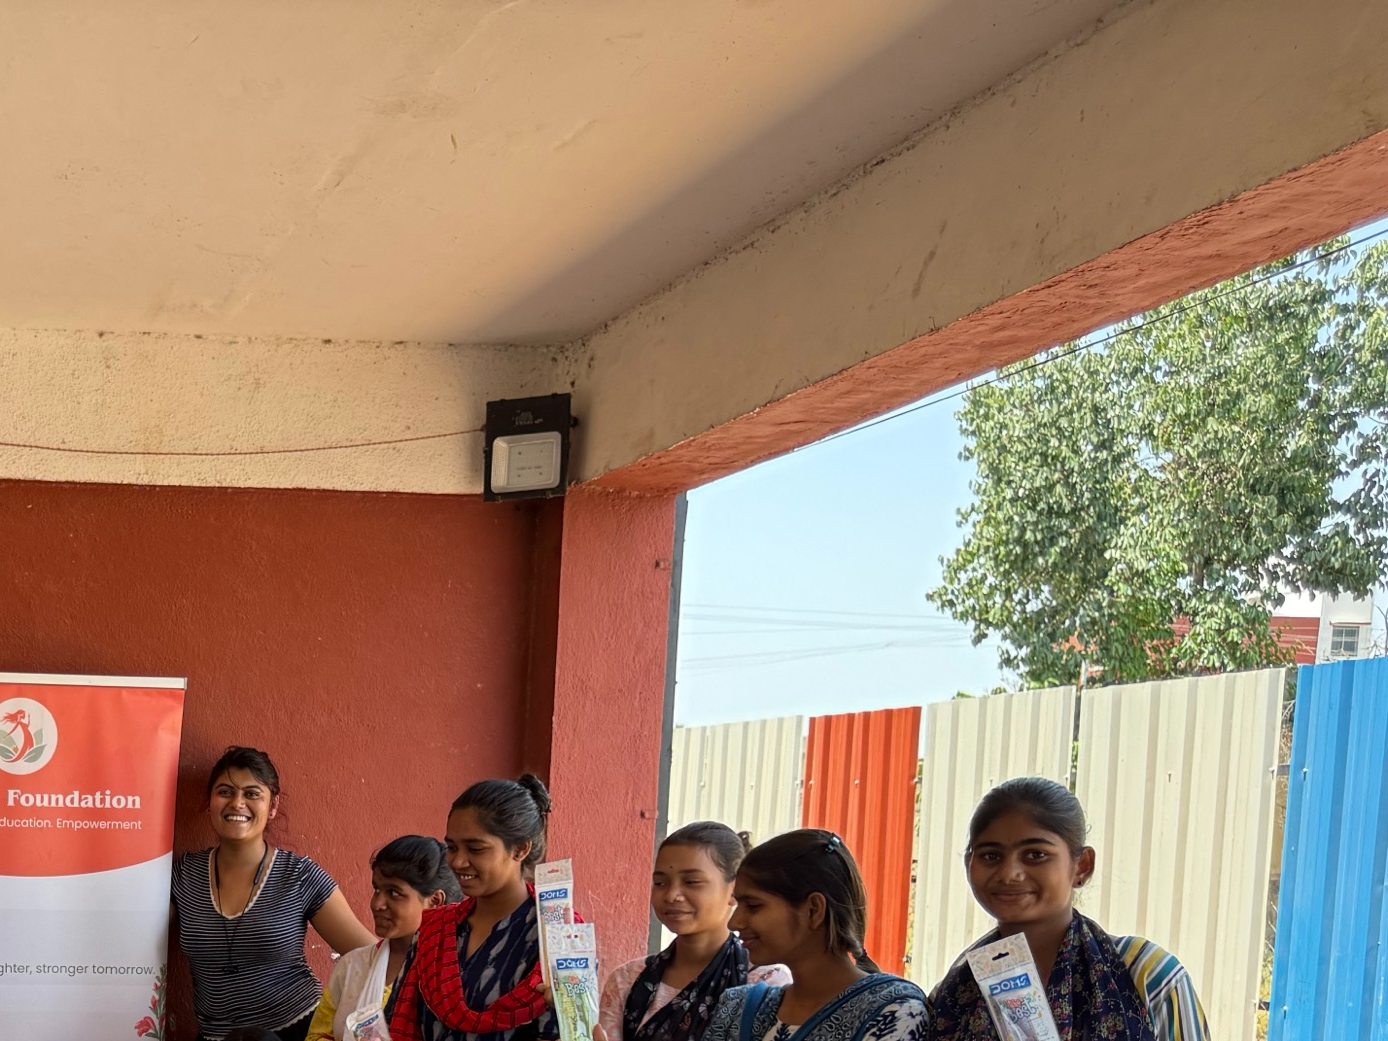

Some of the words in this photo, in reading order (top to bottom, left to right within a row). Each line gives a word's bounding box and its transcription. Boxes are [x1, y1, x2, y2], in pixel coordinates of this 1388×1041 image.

[7, 789, 141, 809] Foundation
[56, 818, 142, 831] Empowerment
[35, 964, 89, 976] stronger
[92, 964, 156, 975] tomorrow.
[991, 975, 1029, 995] DOMS
